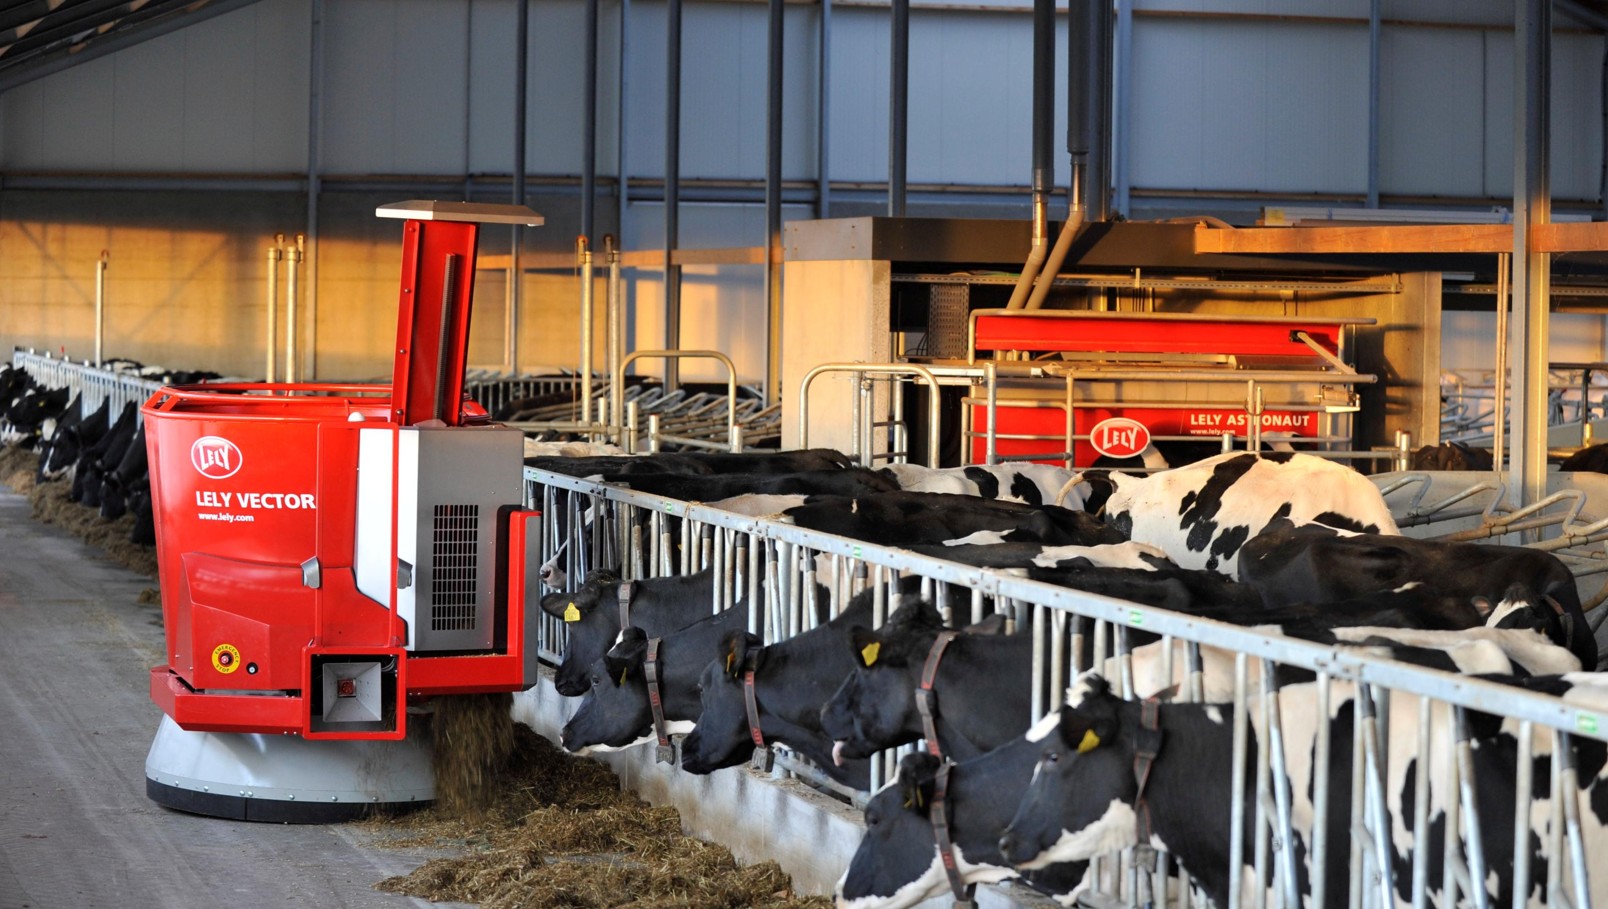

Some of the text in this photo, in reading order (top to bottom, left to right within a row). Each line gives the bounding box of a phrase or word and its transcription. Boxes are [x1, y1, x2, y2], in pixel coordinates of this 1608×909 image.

[1190, 414, 1310, 426] LELY ASONAUT
[1102, 426, 1137, 451] LELY
[1190, 428, 1236, 436] www.lely.com
[198, 444, 230, 471] LELY
[195, 491, 317, 509] LELY VECTOR
[198, 512, 254, 523] www.lely.com
[215, 646, 238, 662] EMERGENCY
[215, 663, 230, 673] STOP
